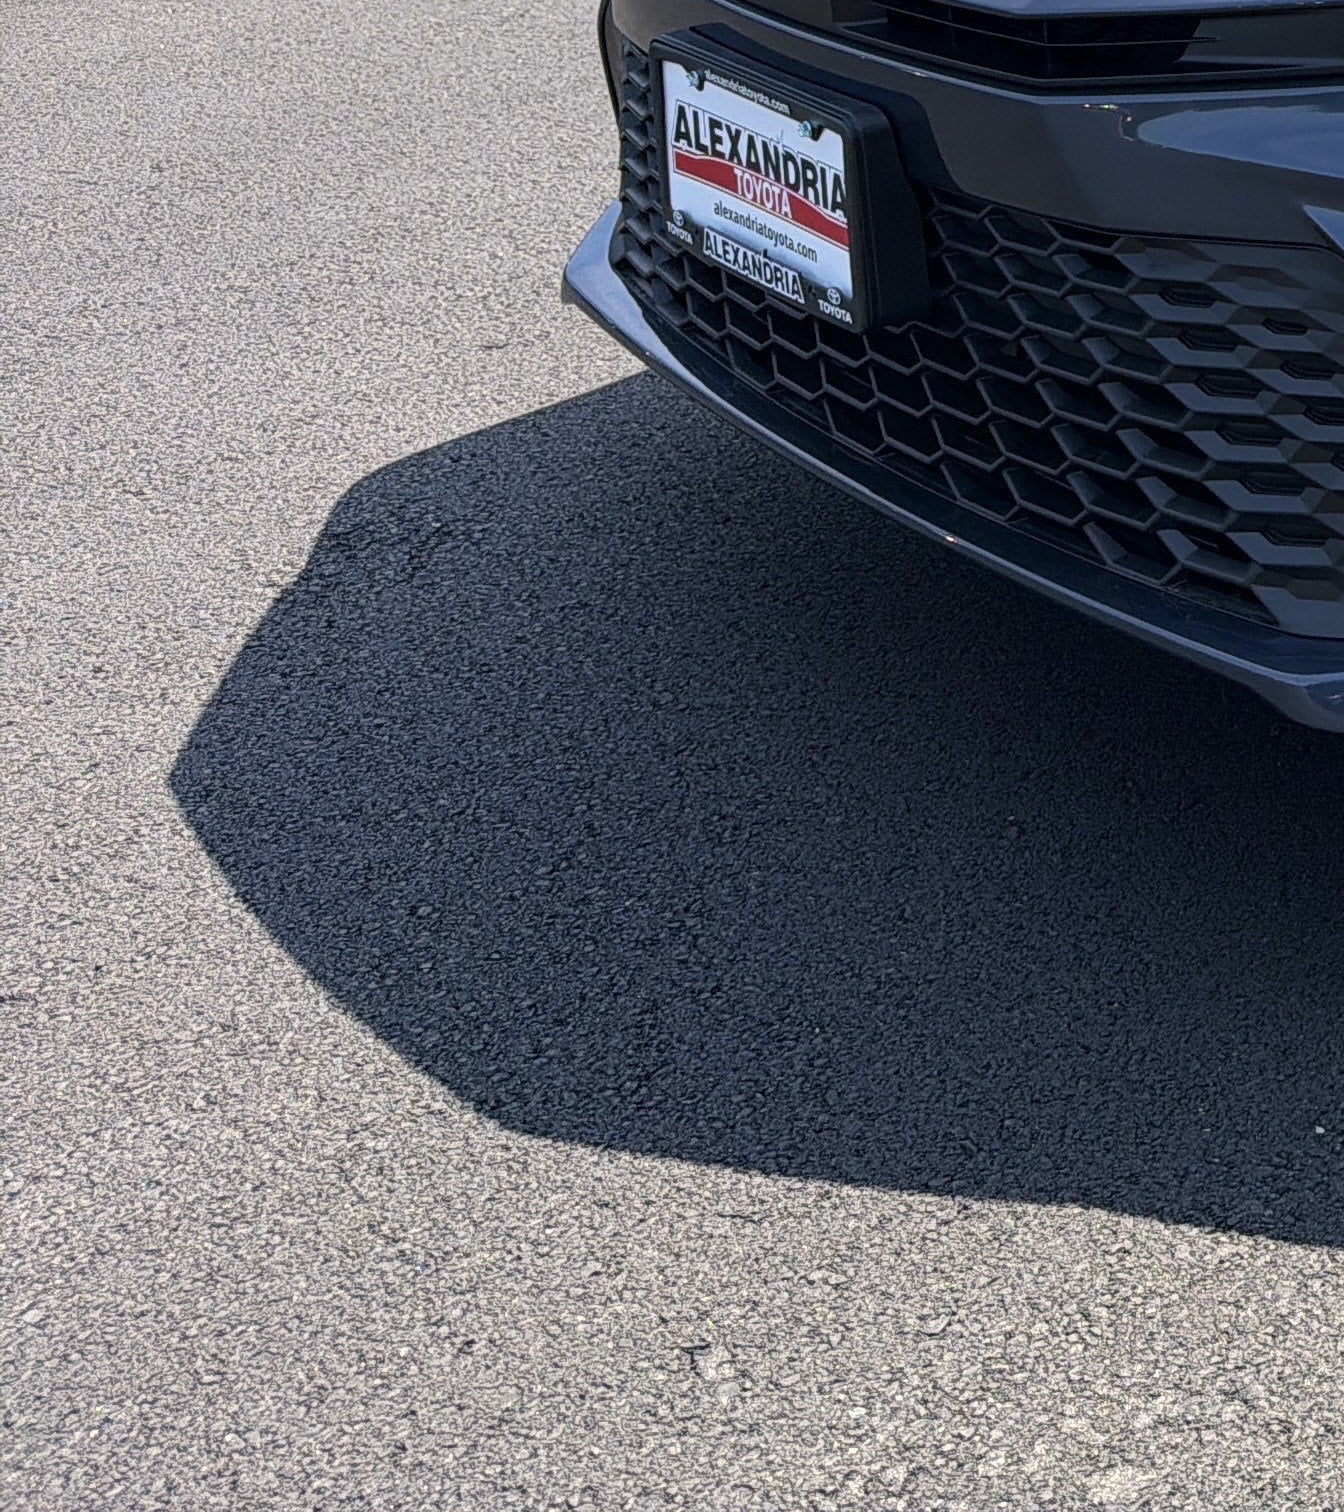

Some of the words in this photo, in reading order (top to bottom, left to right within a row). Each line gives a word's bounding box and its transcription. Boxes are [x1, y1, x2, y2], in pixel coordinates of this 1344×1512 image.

[673, 103, 847, 219] ALEXANDRIA
[734, 167, 793, 220] TOYOTA
[666, 220, 693, 245] TOYOTA
[713, 200, 818, 263] alexandriatoyota.com
[704, 231, 804, 303] ALEXANDRIA
[818, 299, 853, 324] TOYOTA
